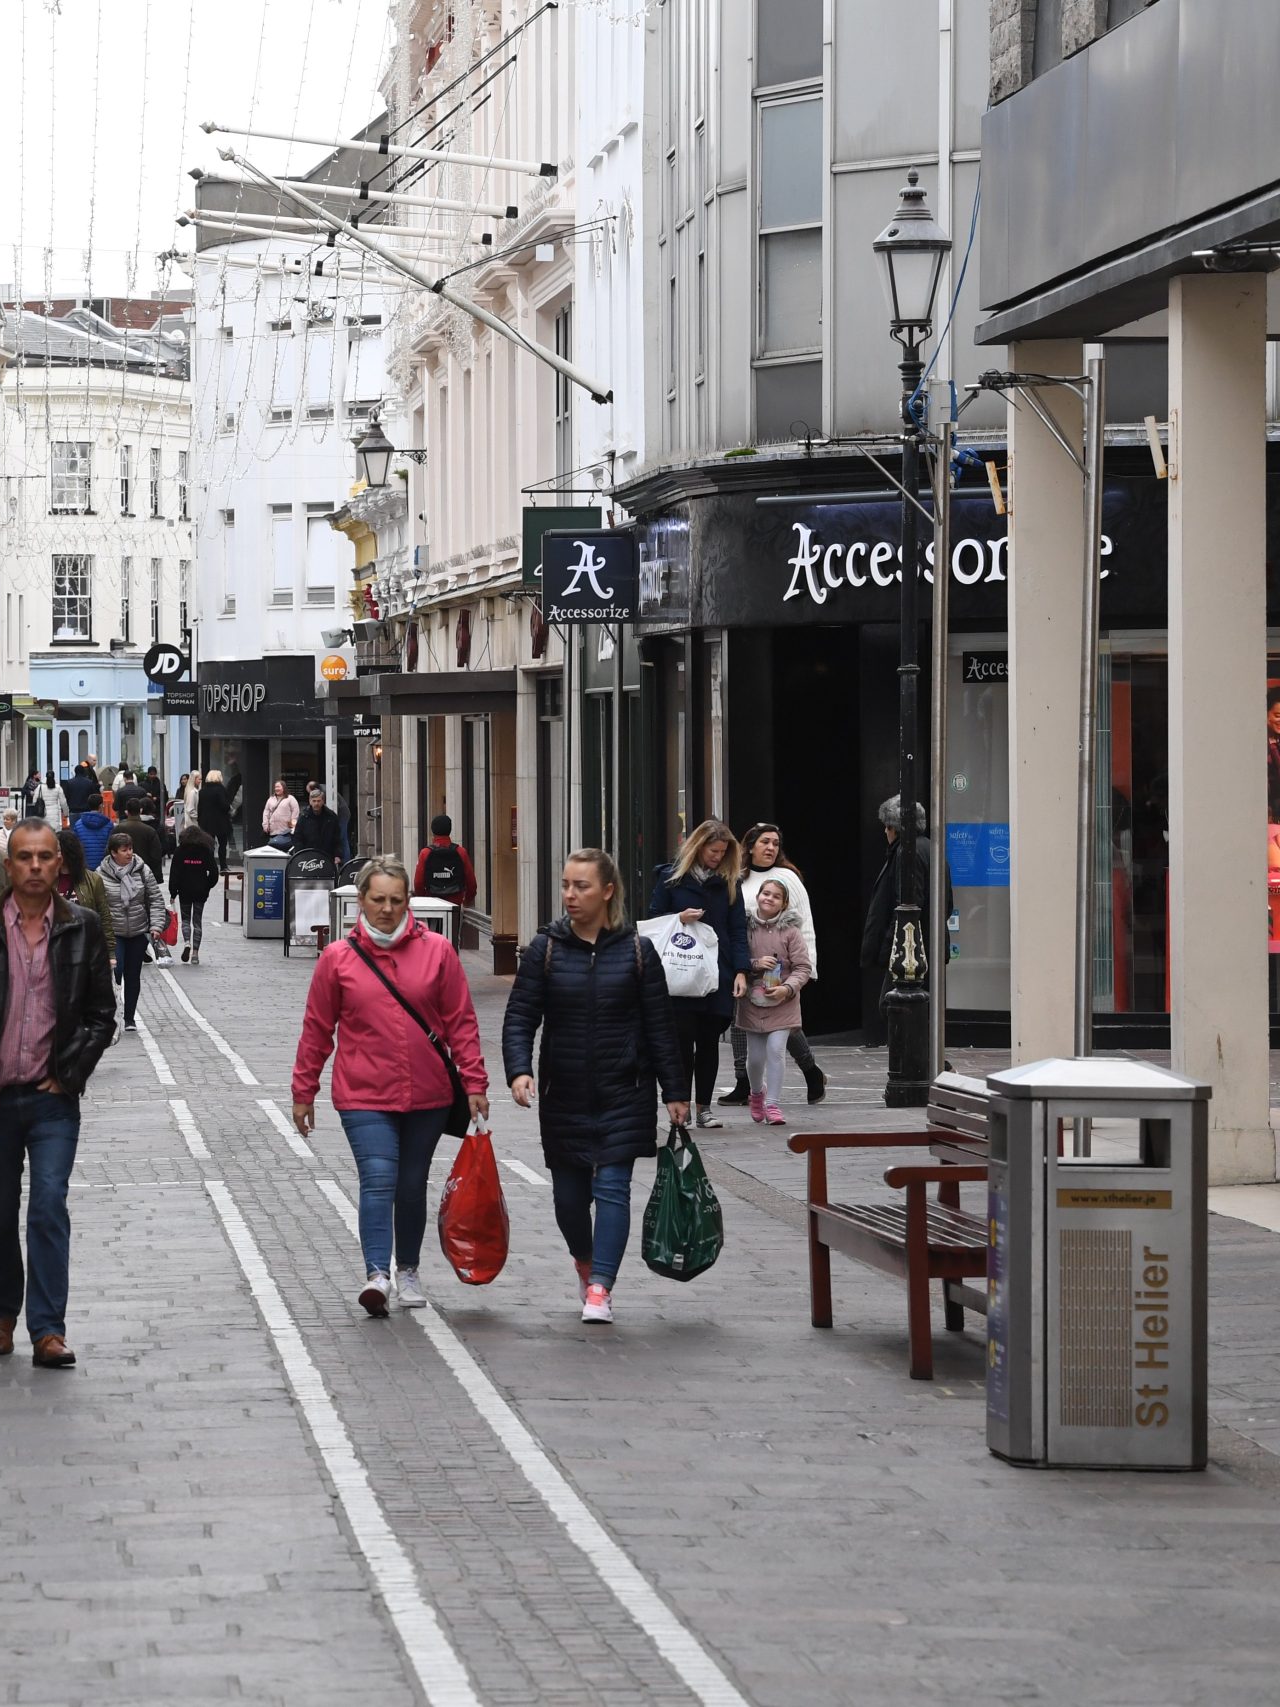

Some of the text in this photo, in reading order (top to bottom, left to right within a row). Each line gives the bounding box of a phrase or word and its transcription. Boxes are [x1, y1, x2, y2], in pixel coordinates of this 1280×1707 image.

[561, 540, 614, 599] A
[547, 603, 630, 622] Accessorize
[151, 653, 180, 675] JD
[202, 683, 266, 713] TOPSHOP
[1135, 1245, 1169, 1428] St Helier
